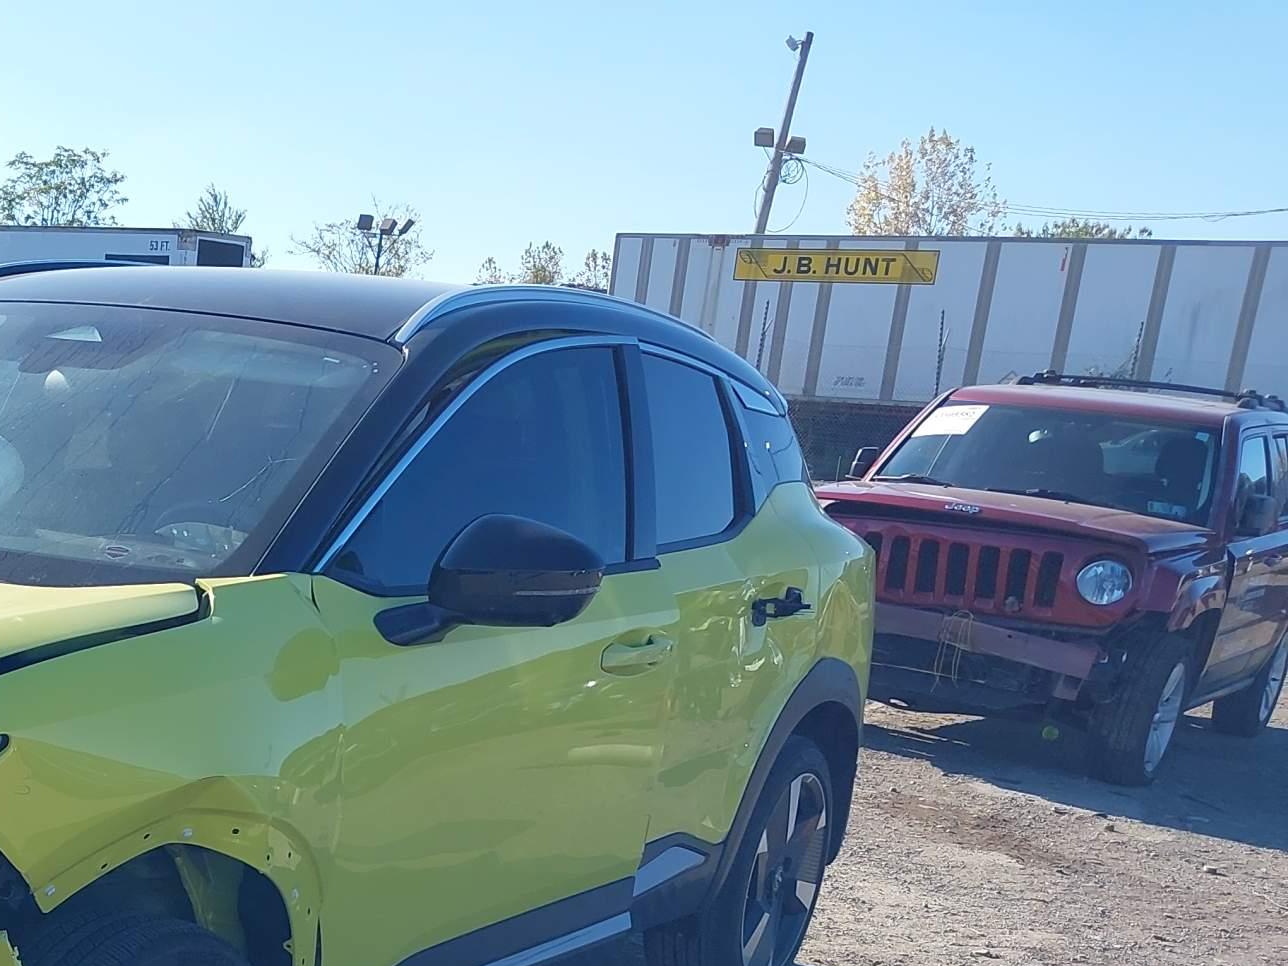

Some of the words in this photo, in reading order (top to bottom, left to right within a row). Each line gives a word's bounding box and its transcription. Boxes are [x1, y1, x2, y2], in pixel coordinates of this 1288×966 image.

[149, 240, 159, 251] 53
[824, 256, 897, 276] HUNT
[944, 502, 979, 514] Jeep
